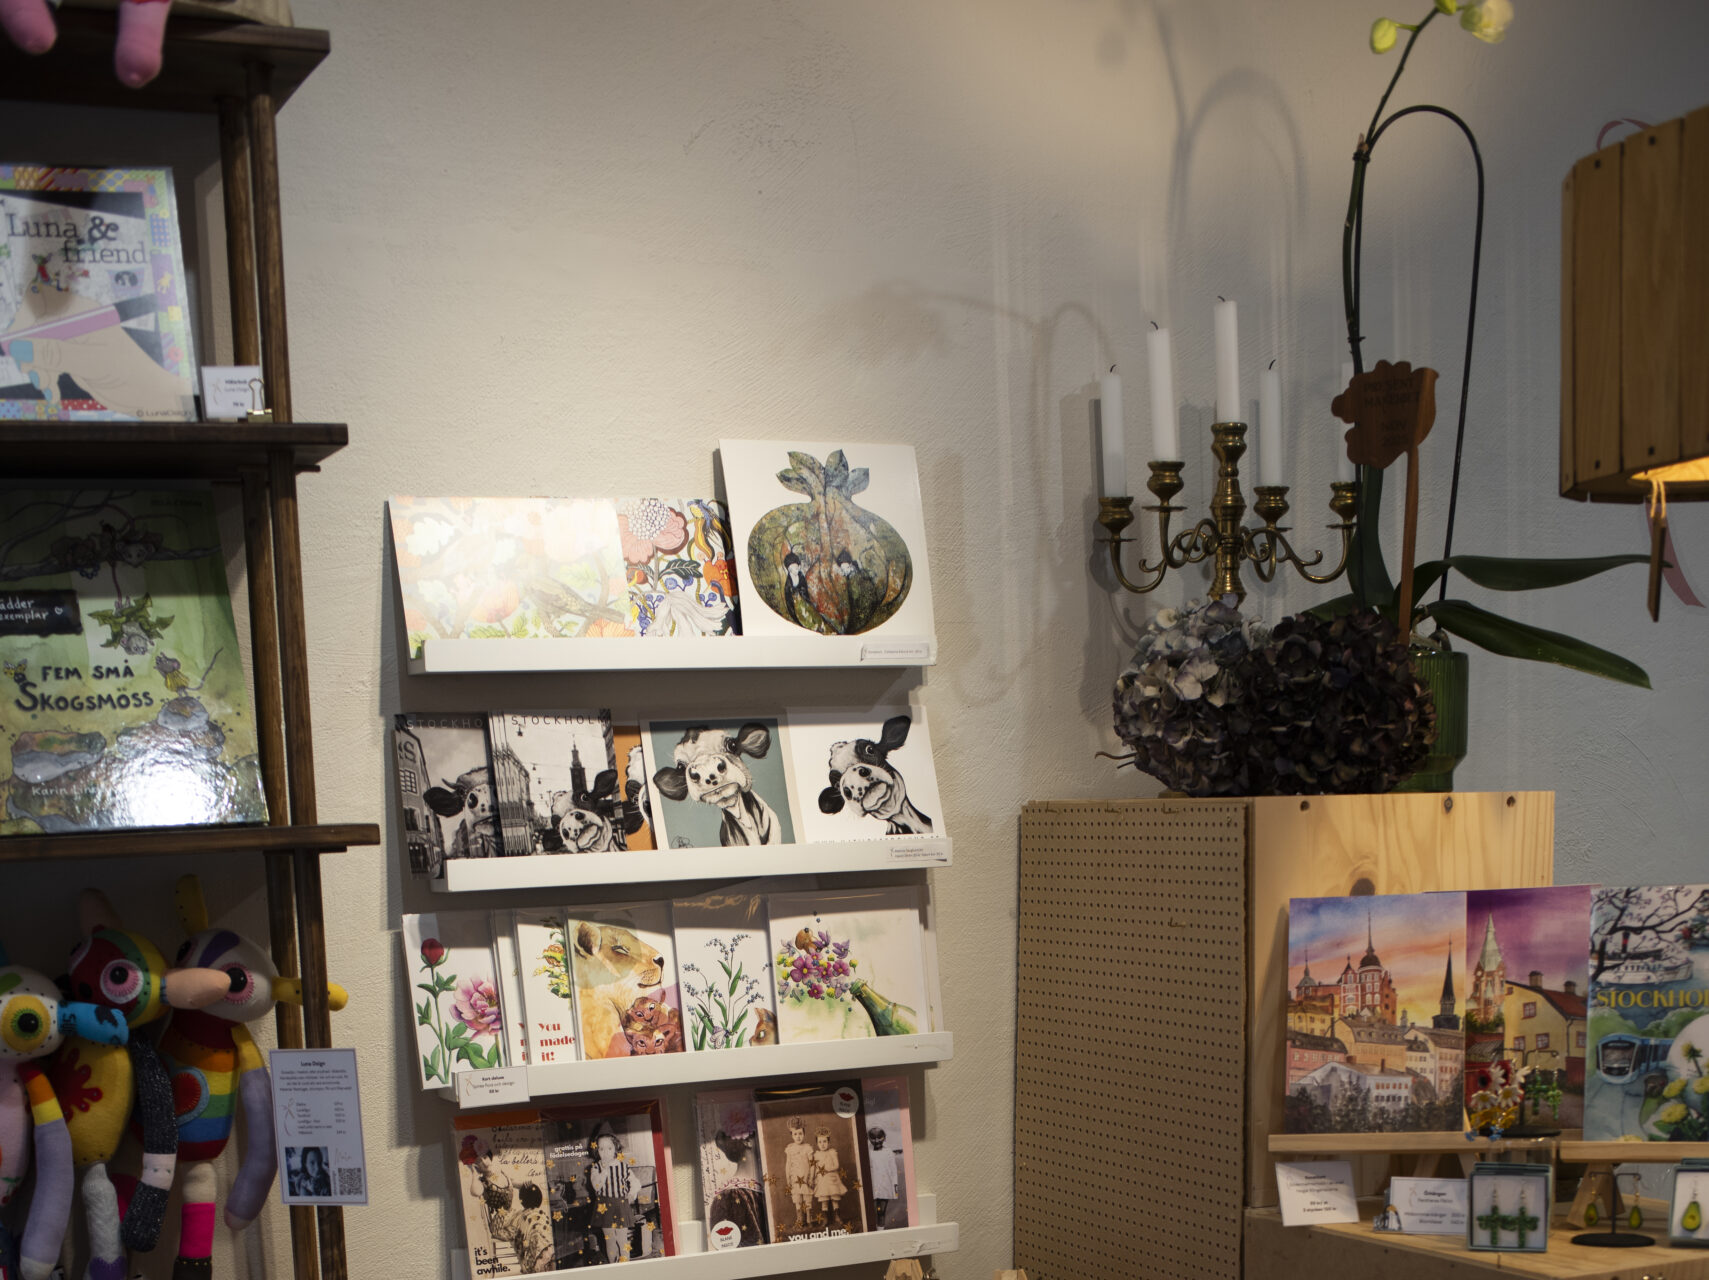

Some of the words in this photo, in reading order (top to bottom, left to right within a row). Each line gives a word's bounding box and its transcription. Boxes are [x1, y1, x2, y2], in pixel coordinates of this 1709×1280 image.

[5, 213, 79, 238] Luna
[62, 240, 147, 265] friend
[41, 666, 82, 682] FEM
[92, 659, 135, 680] SMÅ
[15, 681, 154, 712] SKOGSMÖSS
[538, 1023, 561, 1031] You
[540, 1035, 576, 1047] made
[541, 1051, 555, 1061] it!
[550, 1149, 590, 1159] födelsedagen
[554, 1145, 575, 1154] grattis
[788, 1231, 809, 1242] you
[810, 1227, 829, 1240] and
[475, 1246, 488, 1257] it's
[476, 1256, 499, 1266] been
[477, 1263, 511, 1275] awhile.
